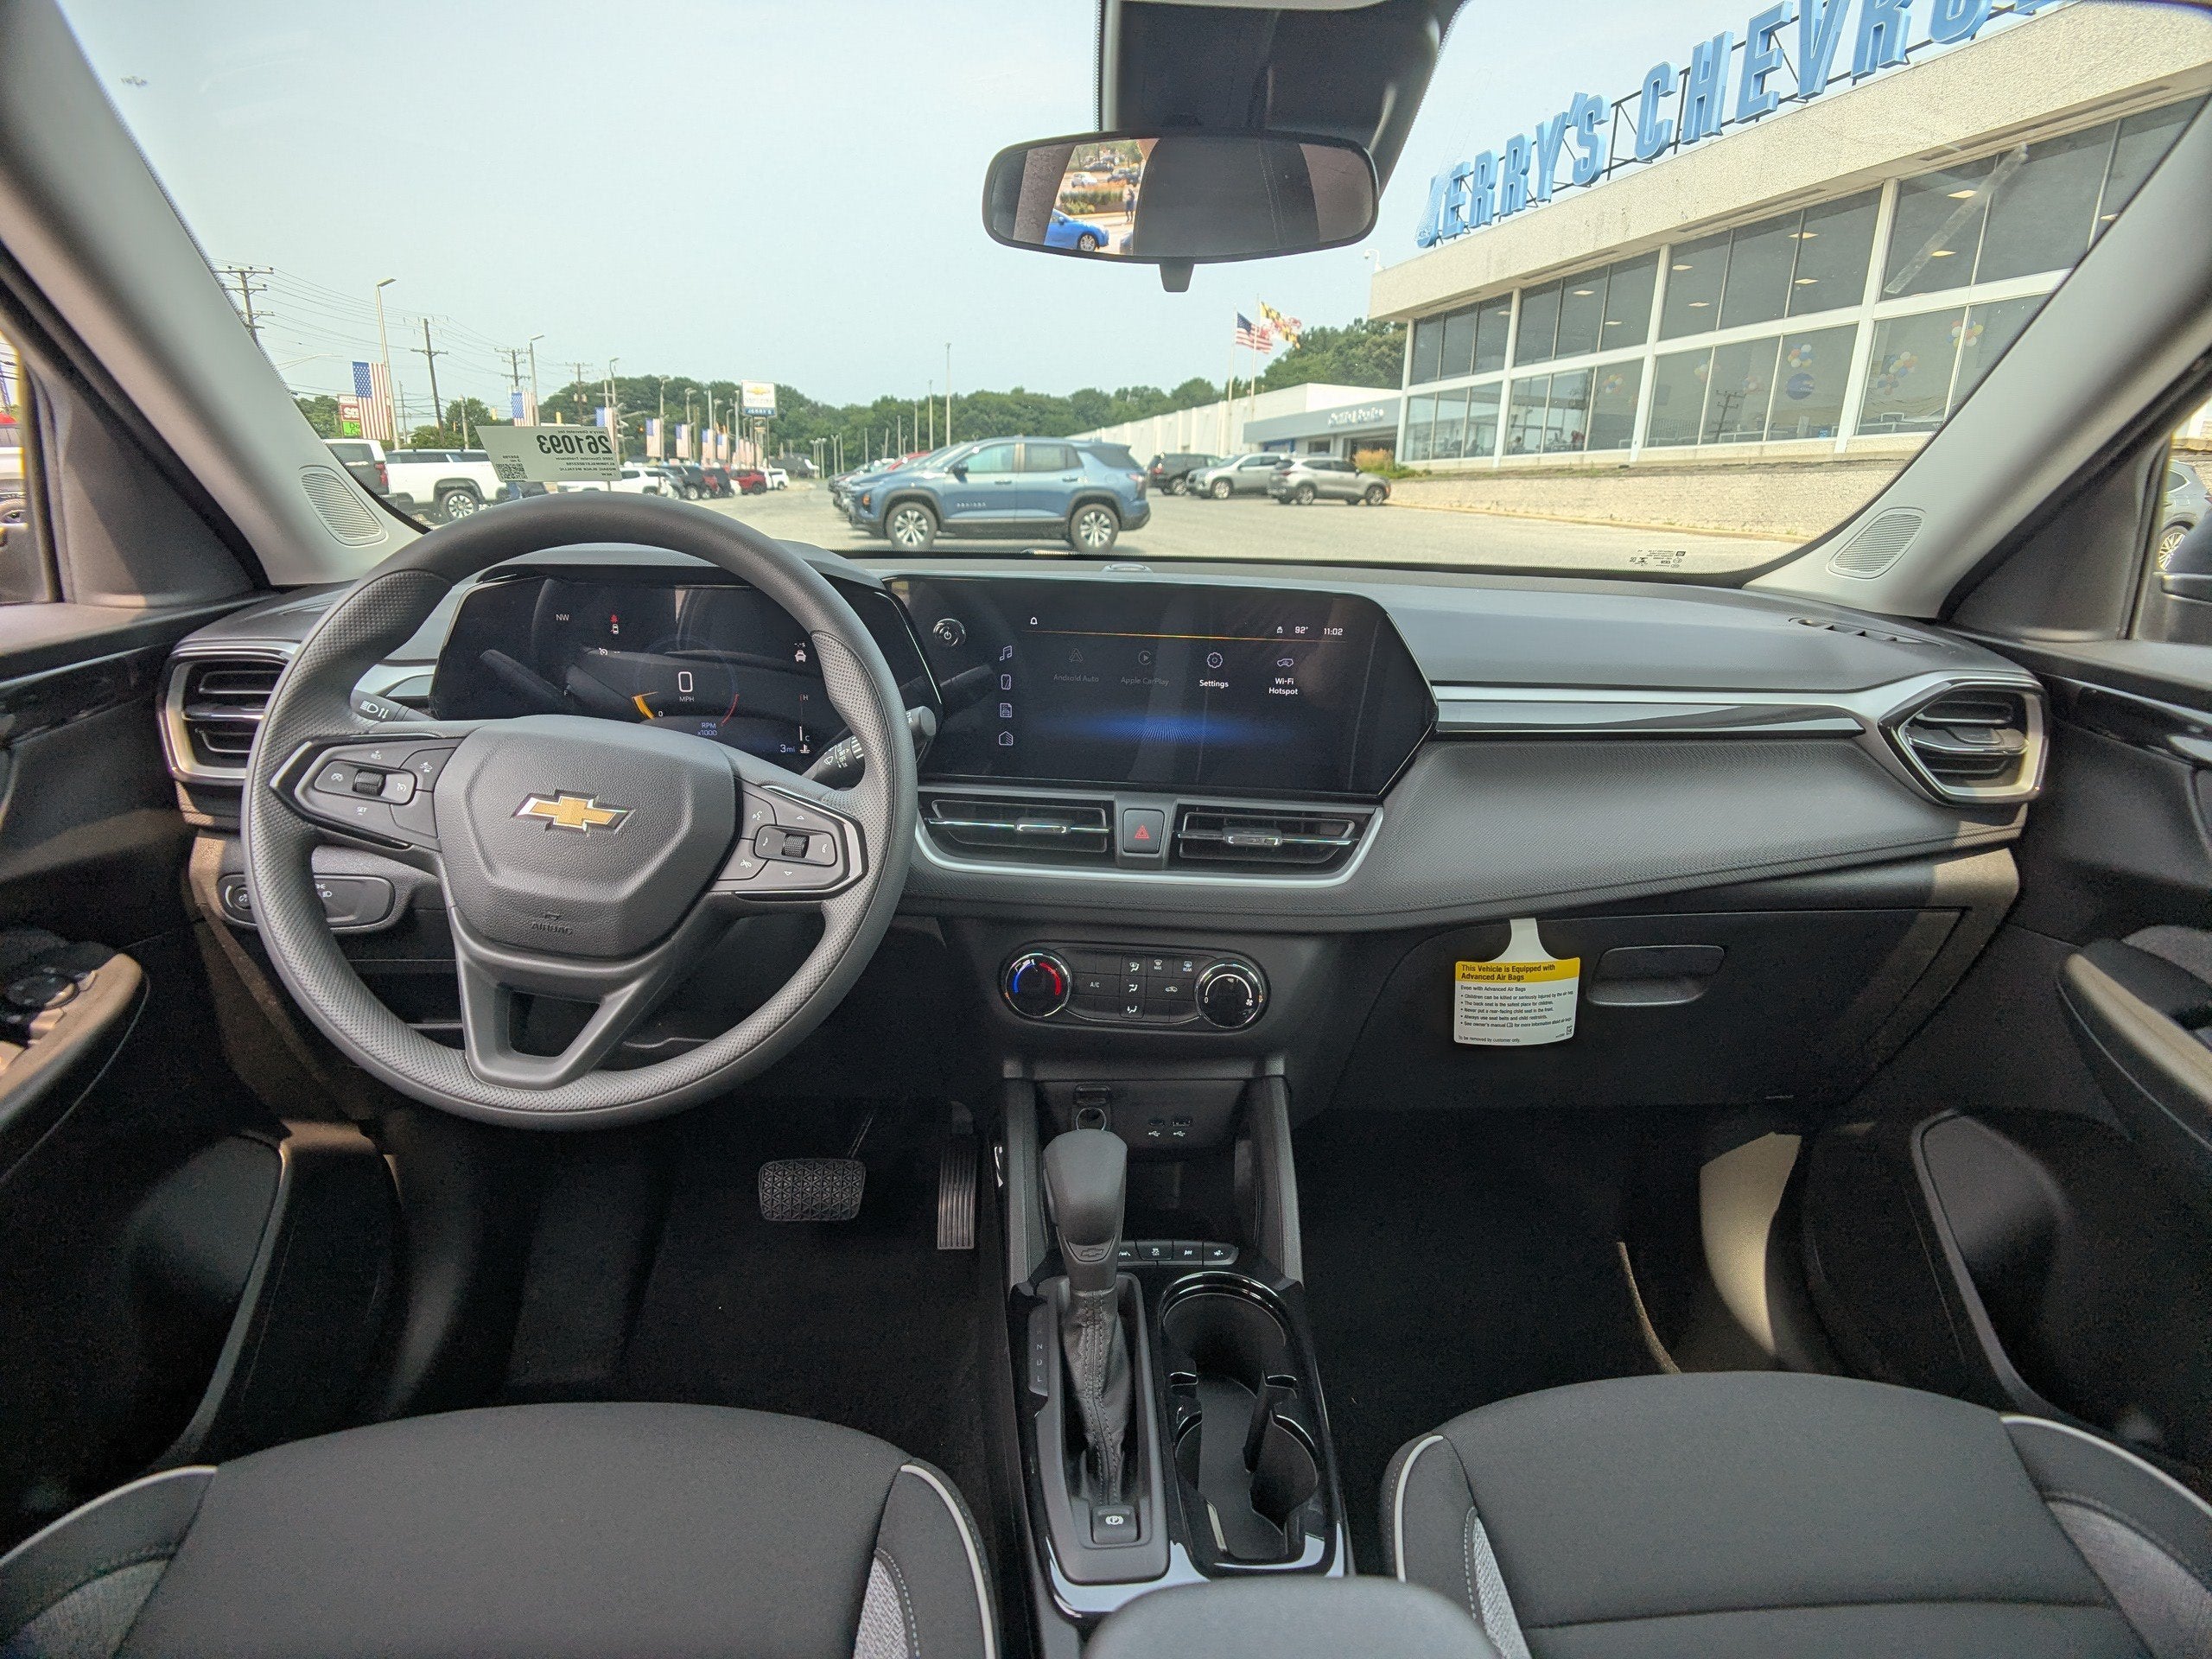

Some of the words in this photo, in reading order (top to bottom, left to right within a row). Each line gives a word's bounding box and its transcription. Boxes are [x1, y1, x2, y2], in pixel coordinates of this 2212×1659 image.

[1414, 92, 1611, 248] JERRY'S
[1324, 627, 1343, 636] 11:02
[677, 671, 693, 692] 0
[1053, 674, 1081, 683] Android
[1121, 677, 1141, 685] Apple
[1142, 677, 1170, 687] CarPlay
[1199, 679, 1230, 690] Settings
[1268, 687, 1298, 696] Hotspot
